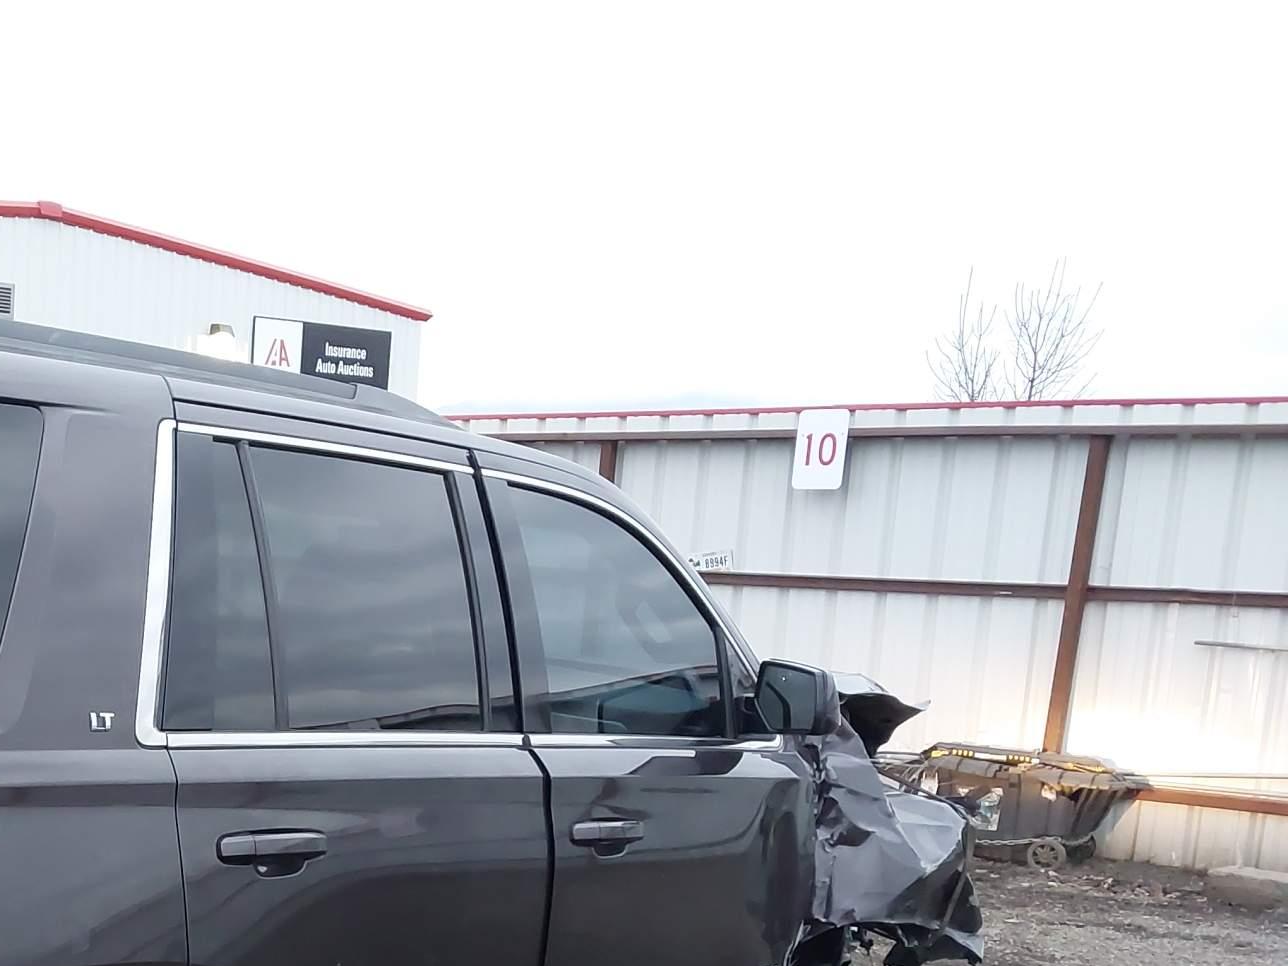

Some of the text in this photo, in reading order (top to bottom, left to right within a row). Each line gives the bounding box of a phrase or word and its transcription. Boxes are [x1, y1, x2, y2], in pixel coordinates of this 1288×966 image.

[324, 341, 367, 360] Insurance
[315, 358, 374, 378] Auto Auctions
[803, 432, 838, 467] 10
[89, 711, 115, 731] LT
